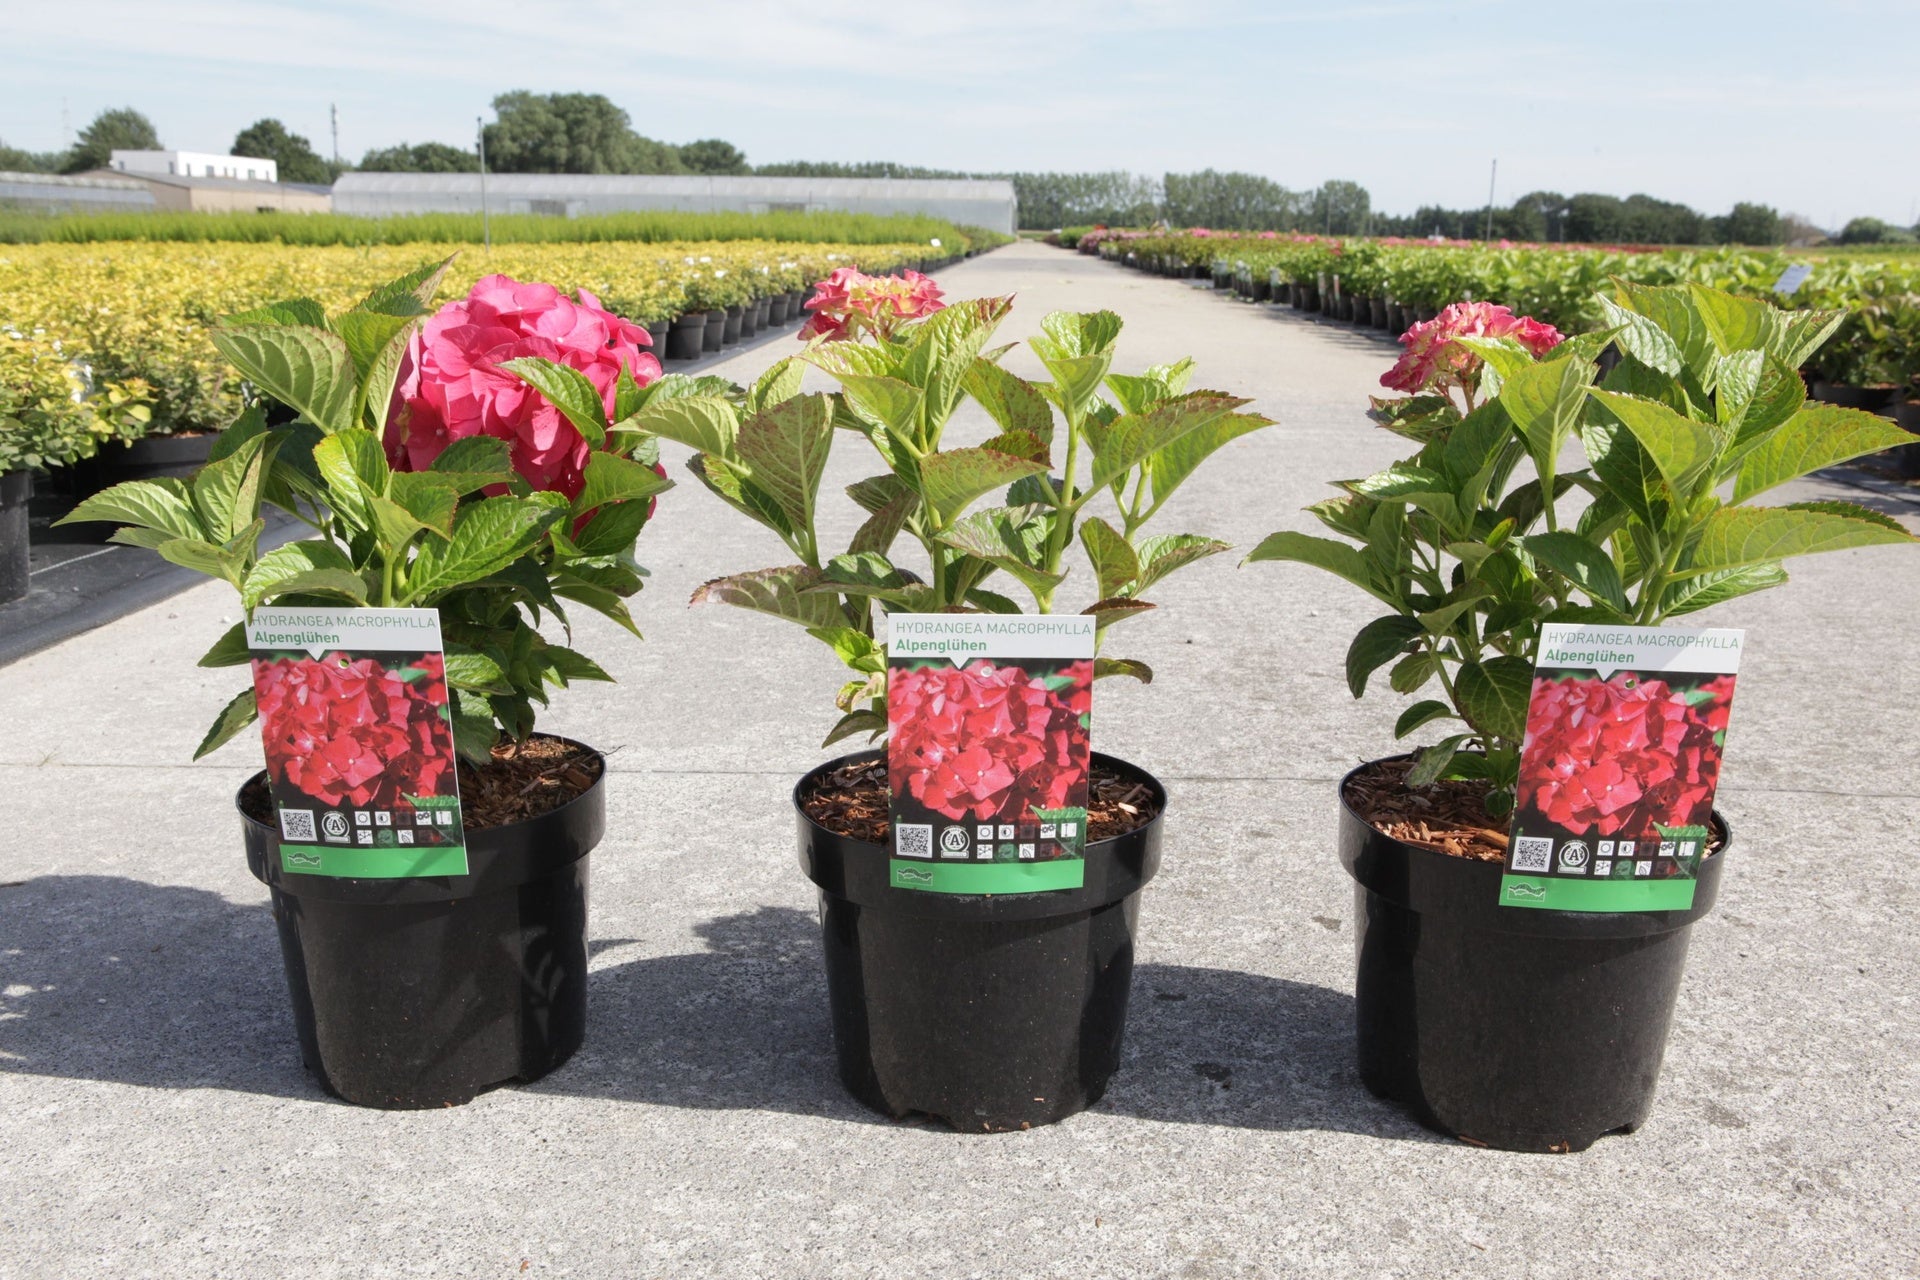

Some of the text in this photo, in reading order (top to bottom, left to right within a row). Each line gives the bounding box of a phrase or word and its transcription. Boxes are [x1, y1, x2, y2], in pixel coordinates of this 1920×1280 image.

[252, 615, 436, 628] HYDRANGEA MACROPHYLLA
[896, 622, 1091, 635] HYDRANGEA MACROPHYLLA
[254, 631, 340, 645] Alpenglühen
[1548, 632, 1739, 649] HYDRANGEA MACROPHYLLA
[895, 639, 987, 653] Alpenglühen
[1545, 649, 1635, 664] Alpenglühen
